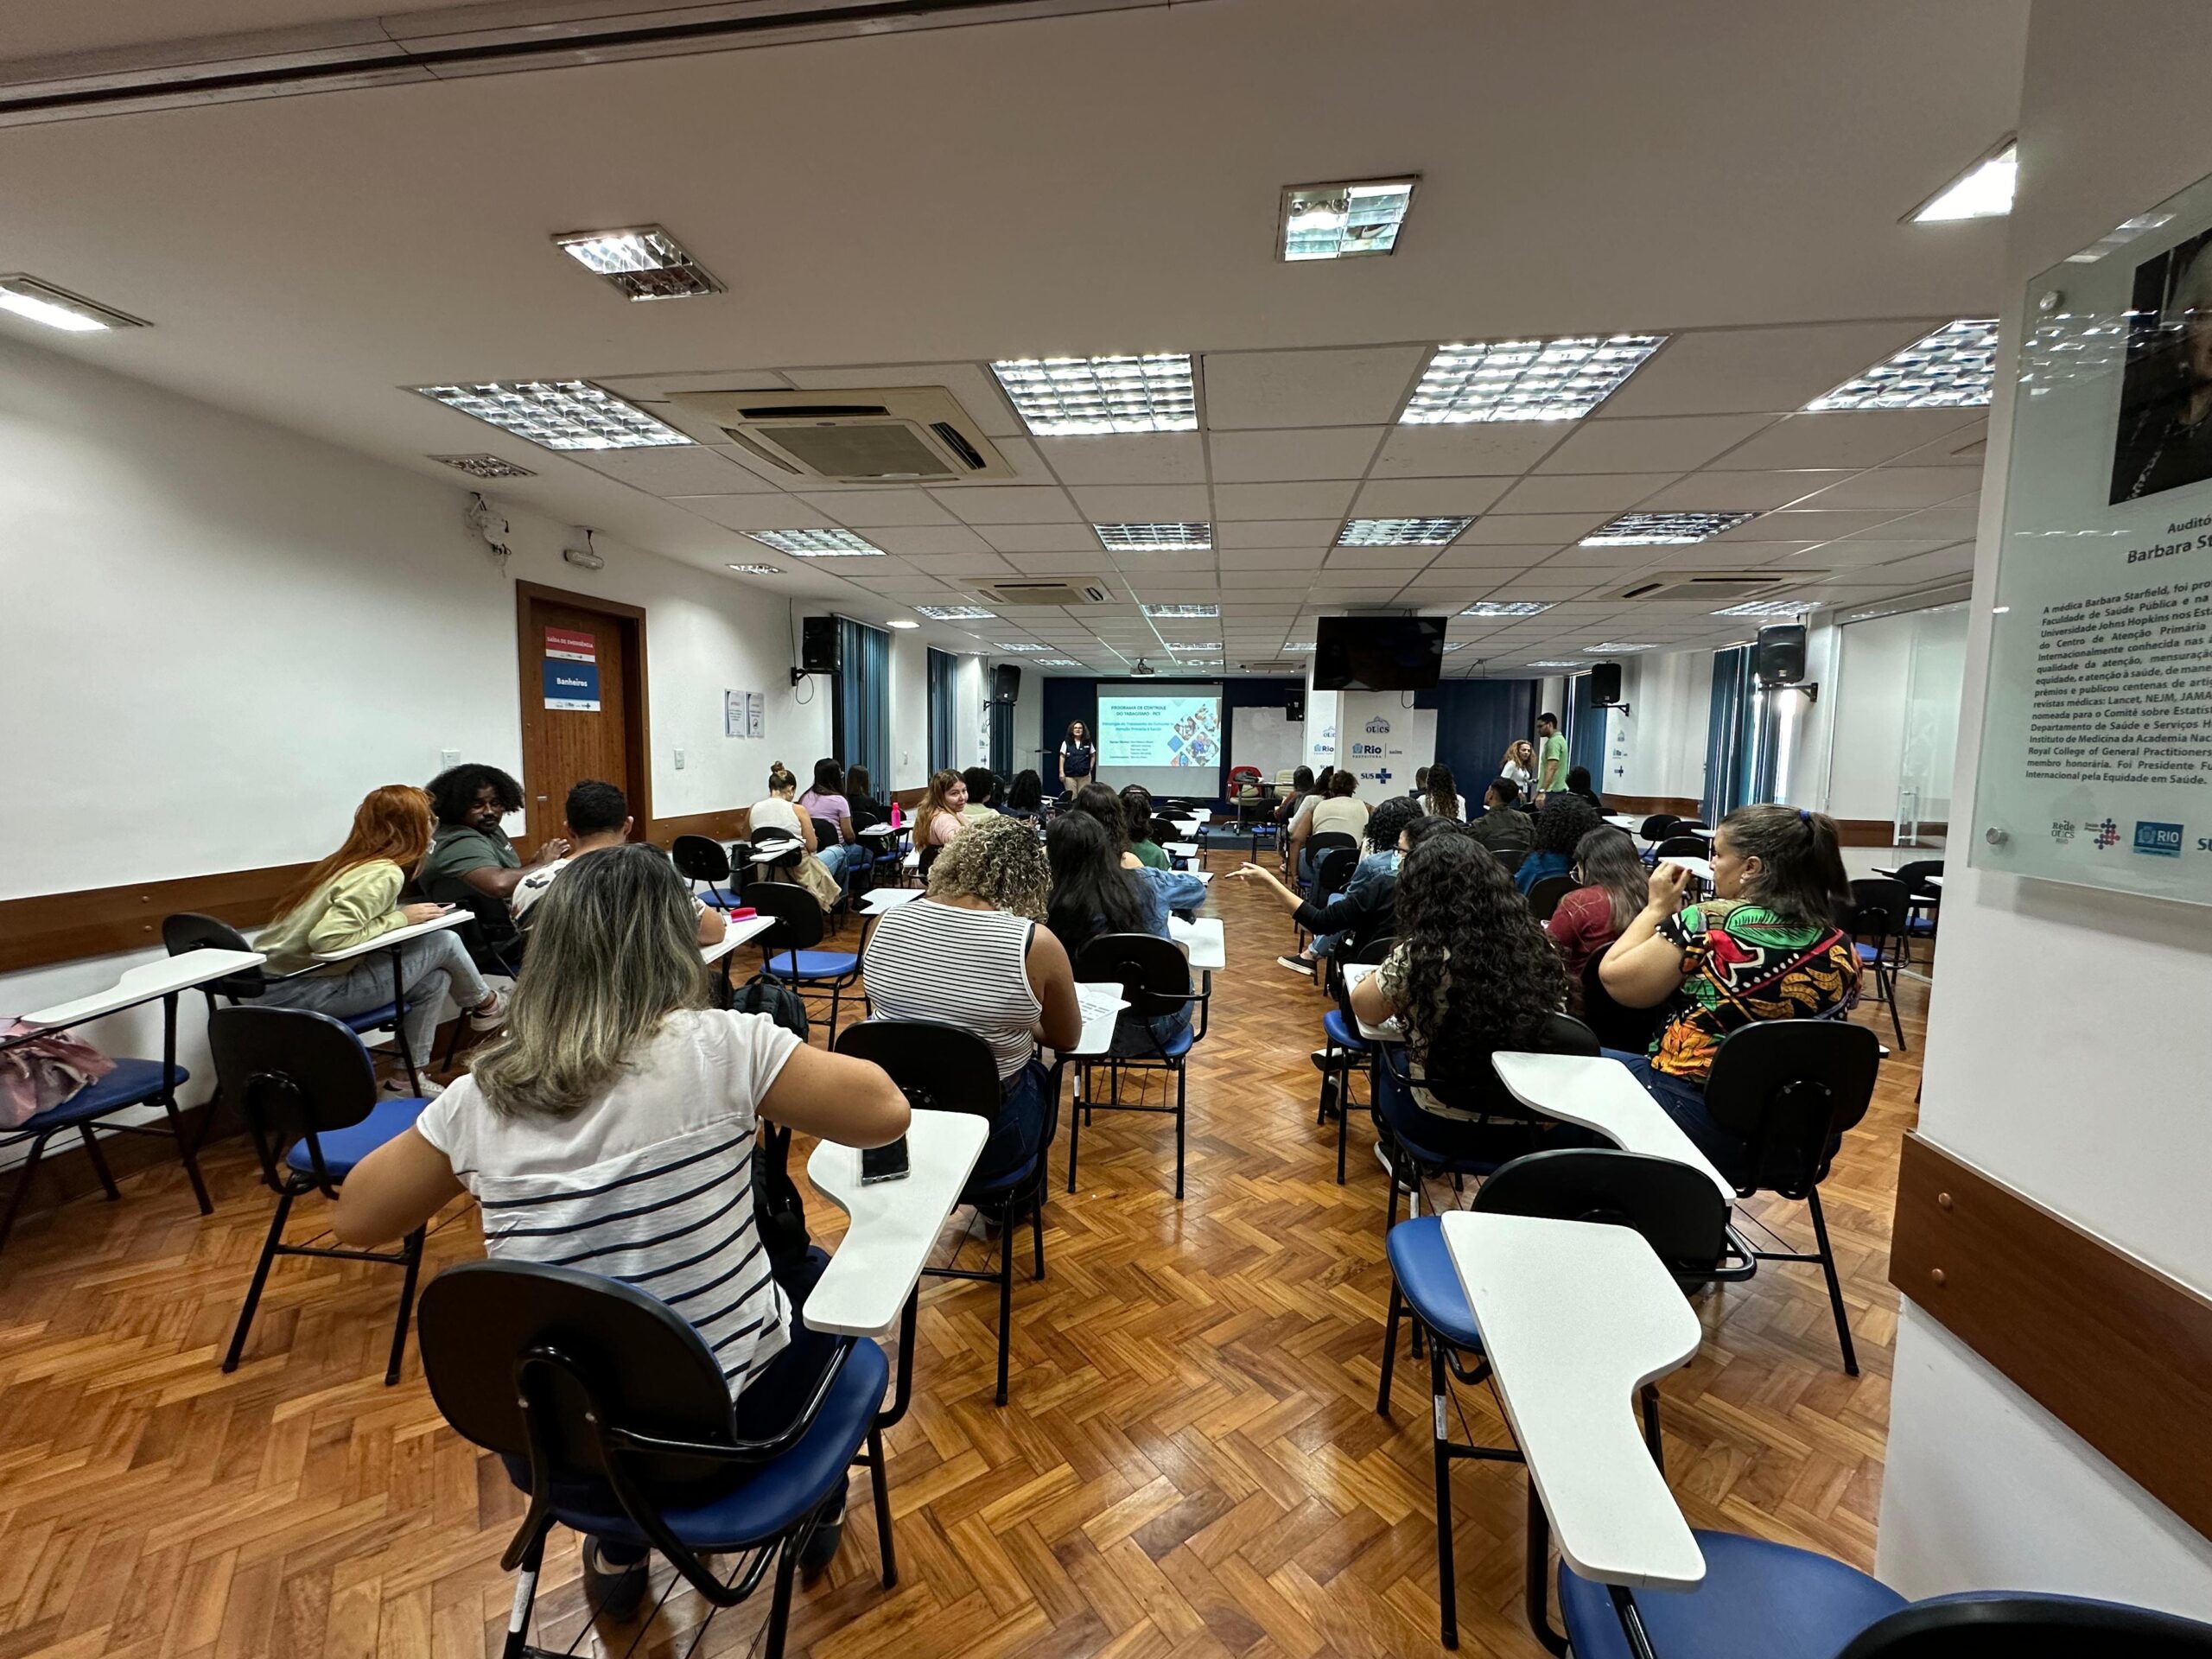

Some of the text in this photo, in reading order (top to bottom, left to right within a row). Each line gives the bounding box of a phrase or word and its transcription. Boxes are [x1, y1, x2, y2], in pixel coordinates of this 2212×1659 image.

[2167, 513, 2212, 534] Auditó
[2127, 535, 2212, 563] Barbara St
[2052, 602, 2082, 613] médica
[2085, 595, 2121, 607] Barbara
[2123, 586, 2170, 601] Starfield,
[2174, 582, 2188, 593] foi
[2042, 613, 2085, 626] Faculdade
[2088, 611, 2101, 620] de
[2105, 605, 2134, 616] Saúde
[2139, 599, 2177, 612] Pública
[2041, 624, 2097, 638] Universidade
[2098, 620, 2125, 631] Johns
[2127, 614, 2170, 626] Hopkins
[2171, 611, 2191, 620] nos
[2056, 639, 2085, 648] Centro
[2092, 634, 2104, 643] de
[2111, 629, 2152, 640] Atenção
[2160, 622, 2206, 635] Primária
[2038, 646, 2124, 661] Internacionalmente
[2127, 640, 2179, 652] conhecida
[2184, 638, 2204, 646] nas
[2037, 663, 2079, 674] qualidade
[2084, 660, 2096, 669] da
[2102, 657, 2142, 667] atenção,
[556, 677, 588, 687] Banheiros
[2035, 675, 2076, 686] equidade,
[2085, 671, 2121, 682] atenção
[2123, 670, 2129, 678] à
[2131, 667, 2163, 677] saúde,
[2165, 665, 2178, 675] de
[2079, 684, 2119, 696] publicou
[2123, 682, 2168, 691] centenas
[2171, 679, 2185, 688] de
[2108, 696, 2142, 704] Lancet,
[2145, 693, 2177, 702] NEJM,
[2032, 710, 2069, 720] nomeada
[2073, 711, 2092, 721] para
[2141, 707, 2170, 716] sobre
[2031, 723, 2092, 733] Departamento
[2109, 721, 2139, 730] Saúde
[2153, 720, 2198, 731] Serviços
[2030, 734, 2064, 743] Instituto
[2065, 734, 2076, 743] de
[2078, 734, 2120, 743] Medicina
[2136, 734, 2187, 742] Academia
[1363, 746, 1382, 754] Rio
[2028, 747, 2212, 757] Royal College of General Practitioners
[2065, 759, 2112, 768] honorária.
[2117, 760, 2132, 769] Foi
[2138, 760, 2194, 770] Presidente
[2025, 771, 2080, 779] Internacional
[2082, 772, 2101, 782] pela
[2103, 772, 2150, 783] Equidade
[2169, 774, 2208, 785] Saúde.
[2052, 821, 2075, 830] Rede
[2157, 830, 2179, 843] RIO
